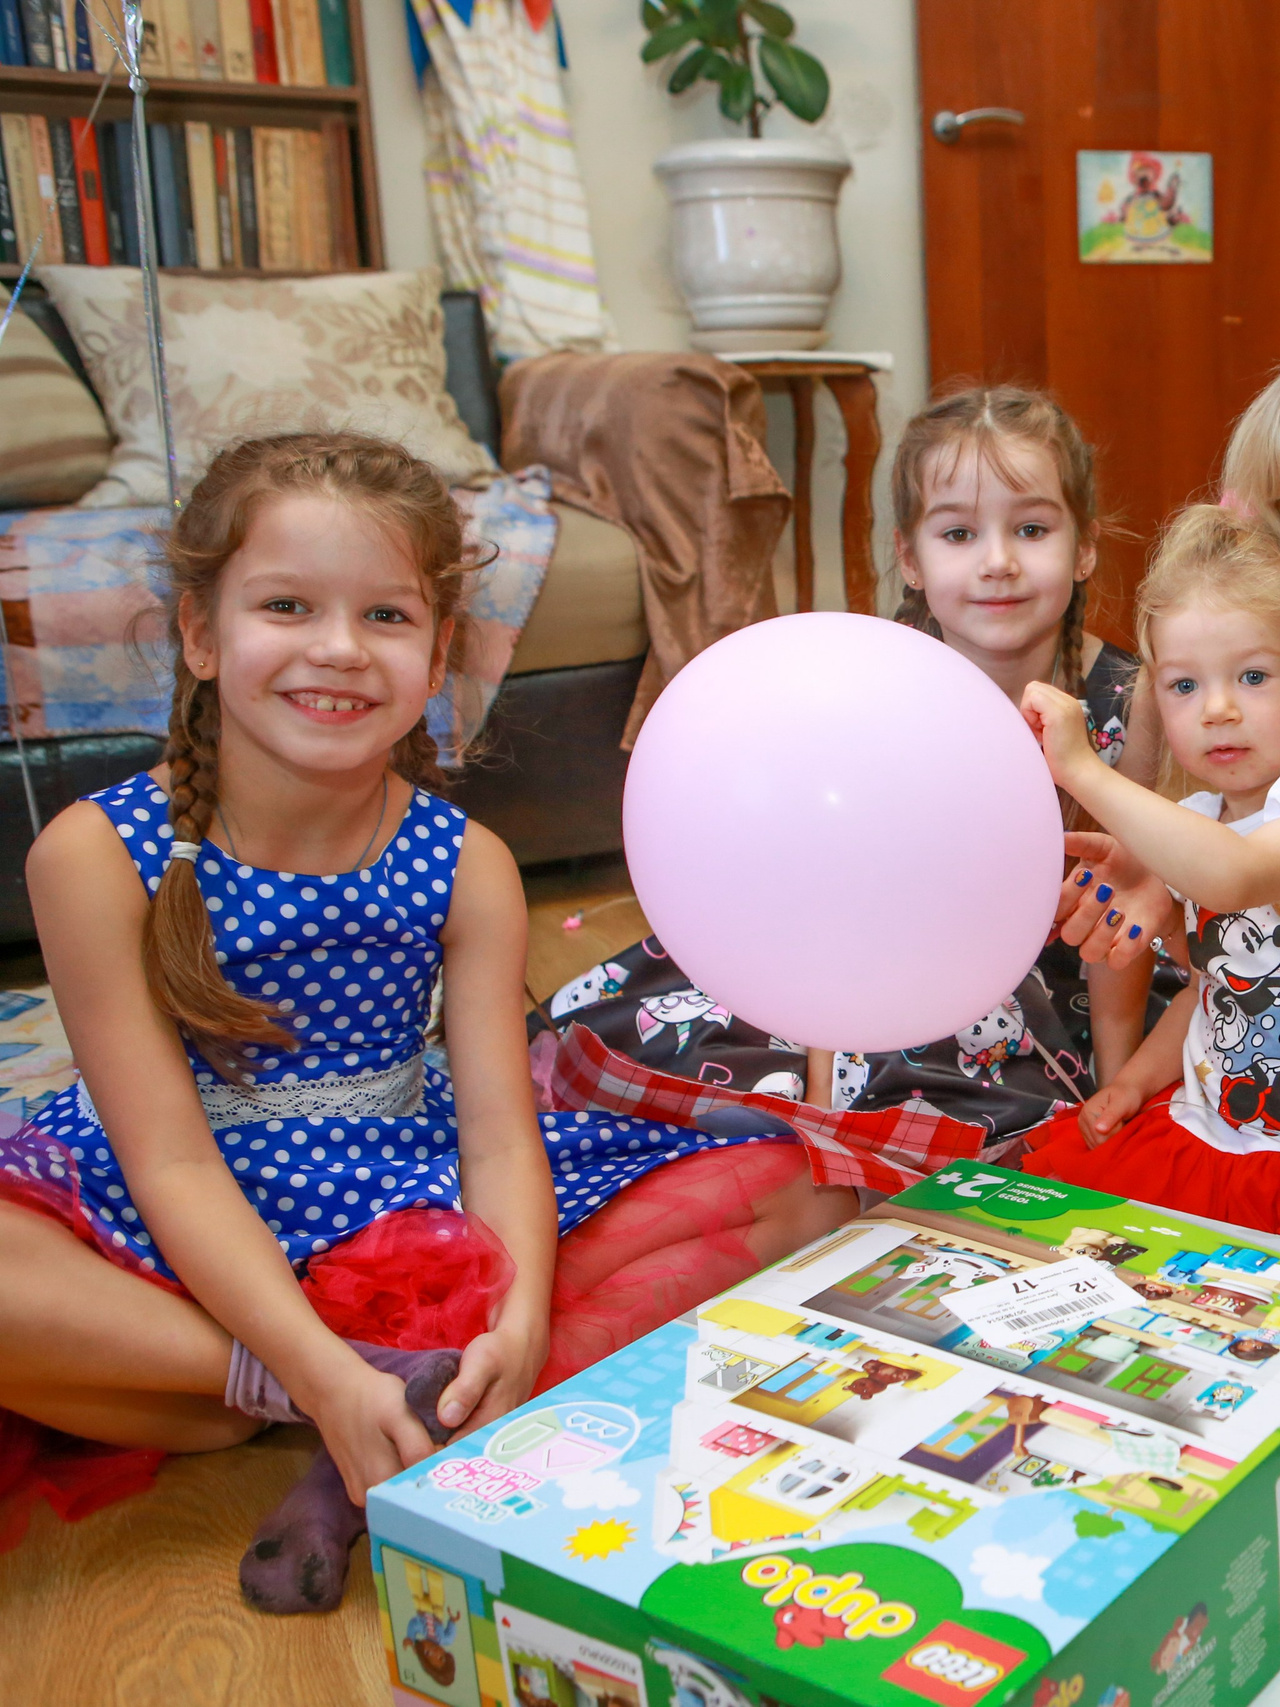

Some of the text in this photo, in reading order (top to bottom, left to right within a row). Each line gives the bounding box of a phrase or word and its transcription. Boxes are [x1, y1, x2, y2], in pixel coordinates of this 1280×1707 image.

[936, 1172, 1008, 1198] 2+
[1007, 1187, 1051, 1202] Modular
[1016, 1182, 1068, 1200] Playhouse
[997, 1193, 1030, 1204] 10929
[1012, 1279, 1039, 1295] 17
[1069, 1280, 1098, 1294] 12
[432, 1460, 520, 1503] IDEAS
[468, 1458, 542, 1491] INCLUDED
[741, 1554, 917, 1641] duplo
[905, 1640, 1004, 1692] LEGO
